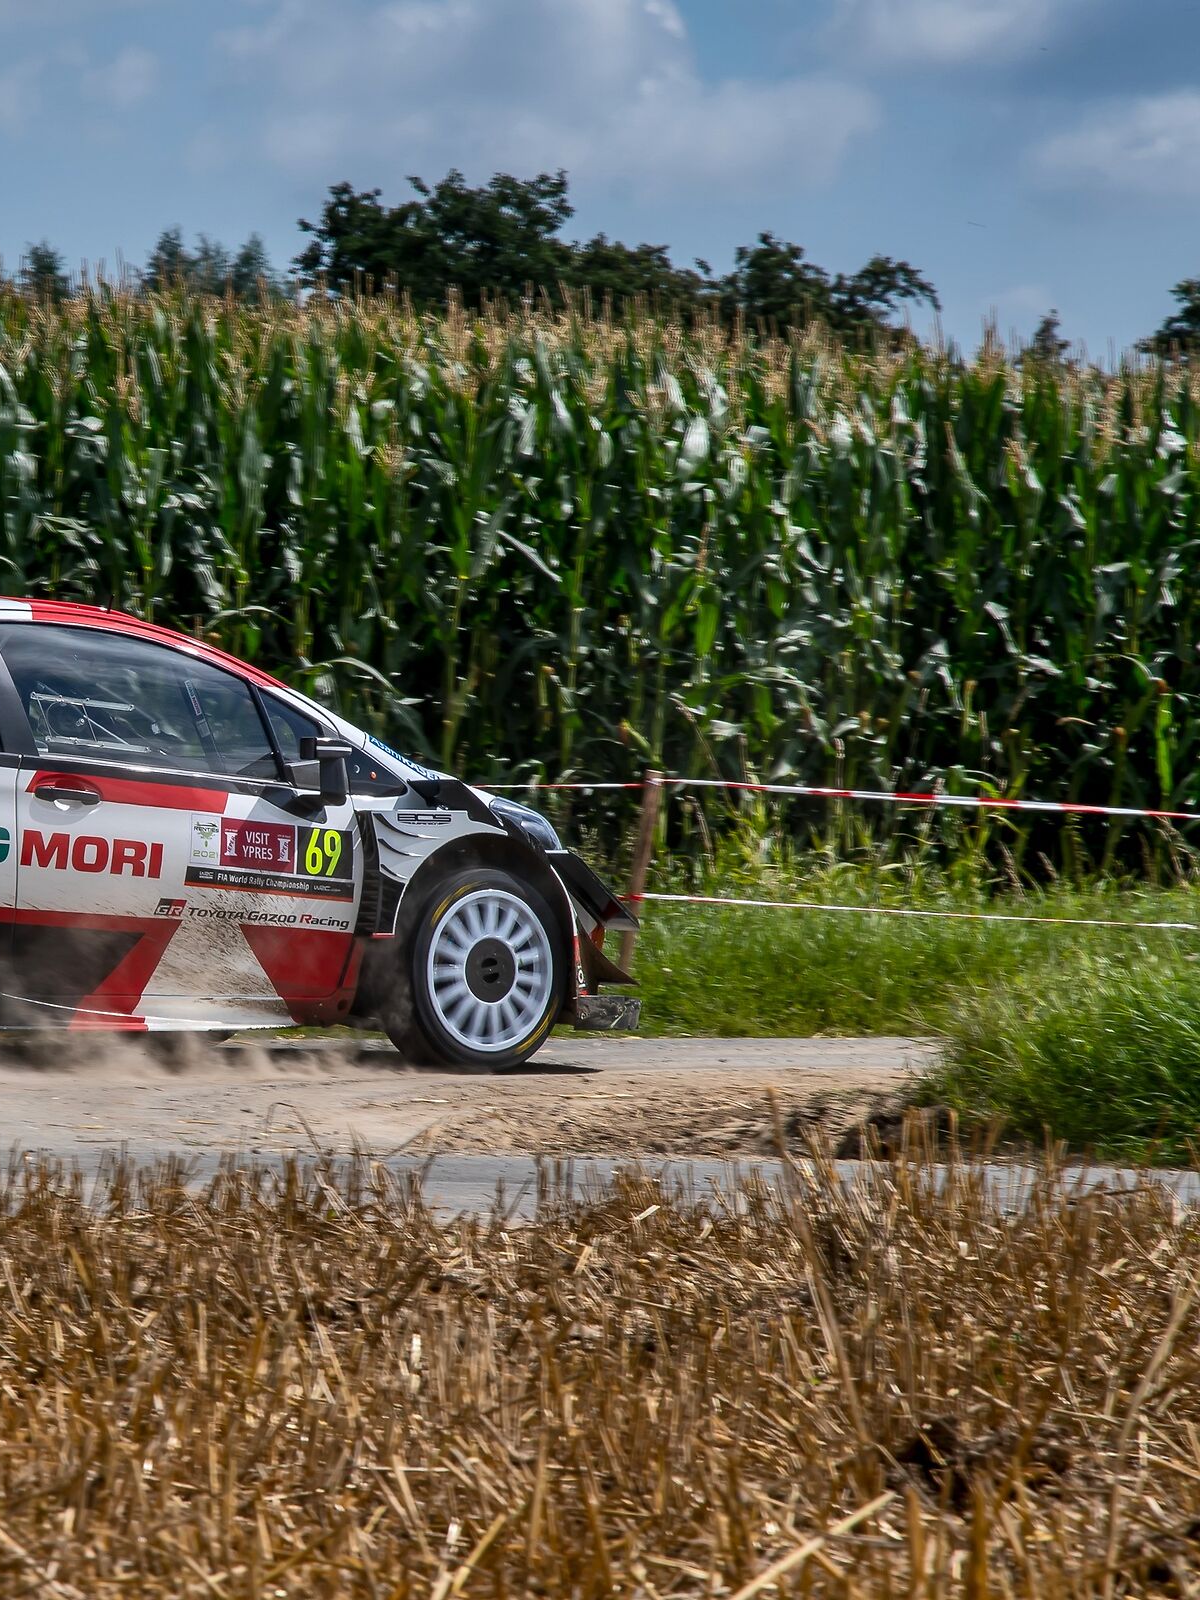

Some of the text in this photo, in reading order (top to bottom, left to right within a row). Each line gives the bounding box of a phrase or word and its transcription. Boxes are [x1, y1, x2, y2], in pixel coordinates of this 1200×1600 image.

[245, 831, 270, 845] VISIT
[20, 829, 164, 879] MORI
[242, 845, 273, 860] YPRES
[305, 828, 342, 876] 69
[217, 873, 228, 881] FIA
[229, 875, 248, 884] World
[249, 877, 265, 887] Rally
[266, 878, 310, 891] Championship
[156, 905, 182, 916] GR
[188, 907, 244, 919] TOYOTA
[300, 914, 350, 931] Racing
